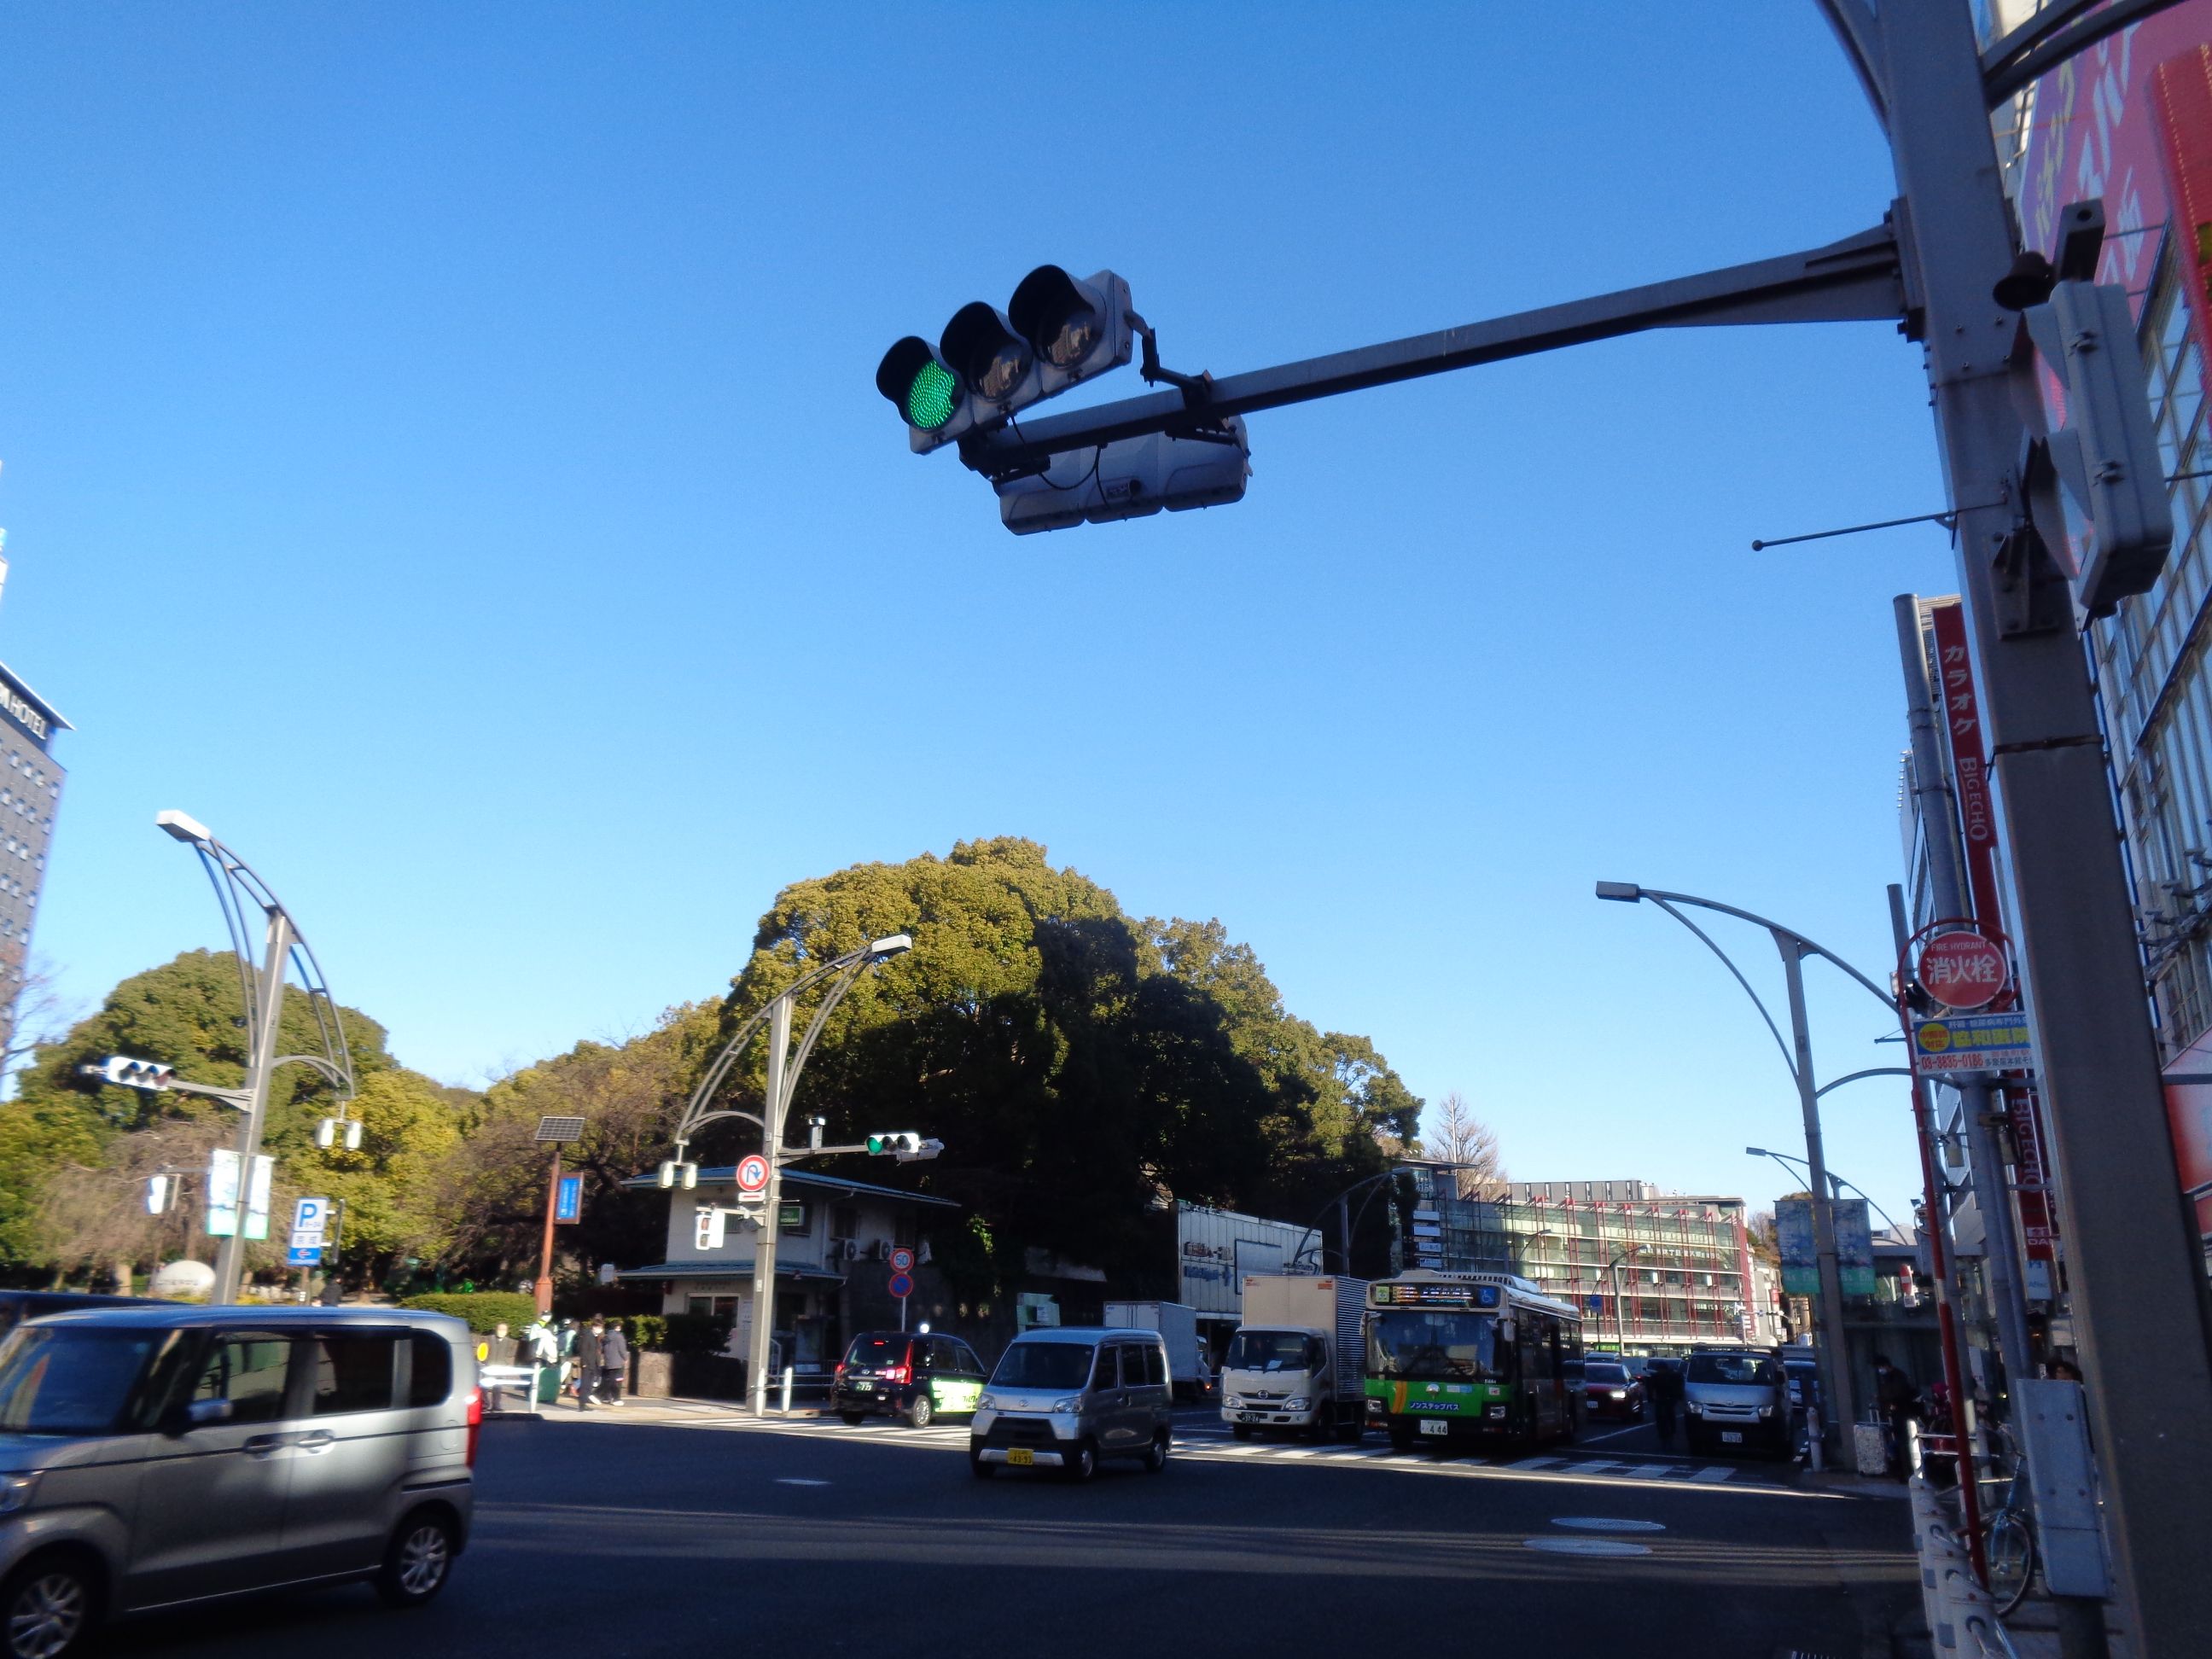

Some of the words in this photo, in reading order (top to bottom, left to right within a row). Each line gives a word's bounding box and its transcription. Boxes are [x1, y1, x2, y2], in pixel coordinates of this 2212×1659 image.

[1945, 644, 1976, 736] カラオケ
[9, 694, 47, 741] HOTEL
[1959, 757, 1981, 790] BIG
[1969, 792, 1990, 841] ECHO
[1931, 943, 1949, 952] FIRE
[1951, 940, 1987, 951] HYDRANT
[1926, 954, 1998, 985] 消火栓
[2011, 1098, 2032, 1135] BIG
[299, 1203, 317, 1227] P
[895, 1254, 909, 1266] 50
[1409, 1401, 1459, 1411] ノンステップバス
